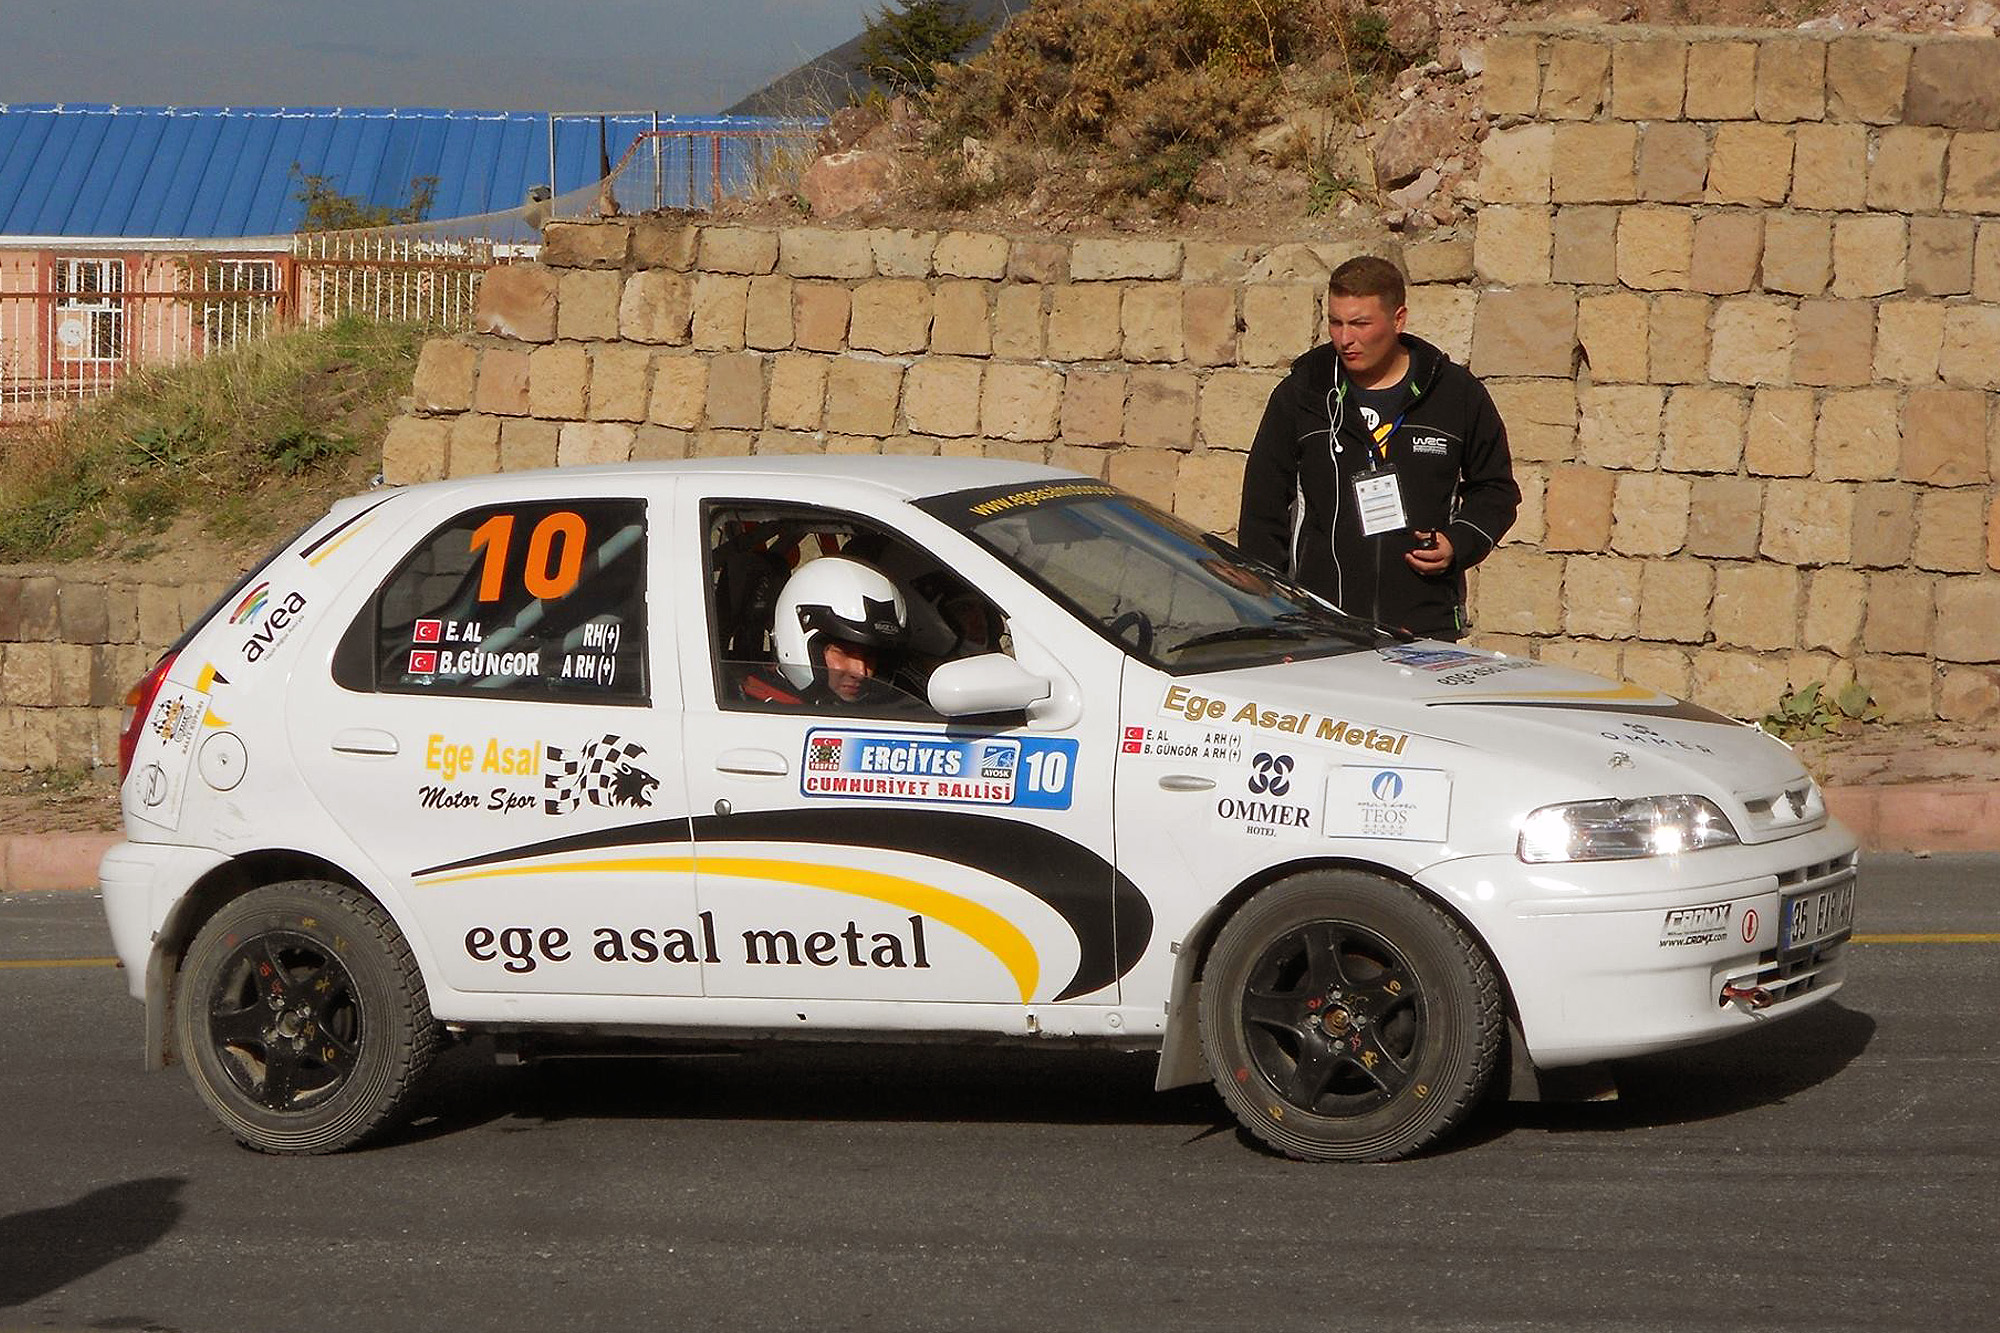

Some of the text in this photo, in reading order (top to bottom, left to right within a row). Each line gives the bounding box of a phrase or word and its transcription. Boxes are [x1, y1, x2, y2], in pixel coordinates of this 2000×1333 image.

[469, 511, 587, 602] 10
[242, 591, 307, 663] avea
[462, 622, 482, 643] AL
[1162, 684, 1409, 756] Ege Asal Metal
[1144, 744, 1153, 755] B.
[1212, 748, 1226, 759] RH
[1146, 729, 1155, 740] E.
[1157, 730, 1169, 741] AL
[1213, 733, 1227, 745] RH
[425, 733, 542, 782] Ege Asal
[860, 743, 962, 775] ERCİYES
[1025, 750, 1068, 794] 10
[418, 785, 537, 815] Motor Spor
[1217, 797, 1312, 829] OMMER
[1361, 808, 1408, 824] TEOS
[1246, 825, 1277, 838] HOTEL
[1791, 897, 1808, 942] 35
[464, 909, 931, 974] ege asal metal
